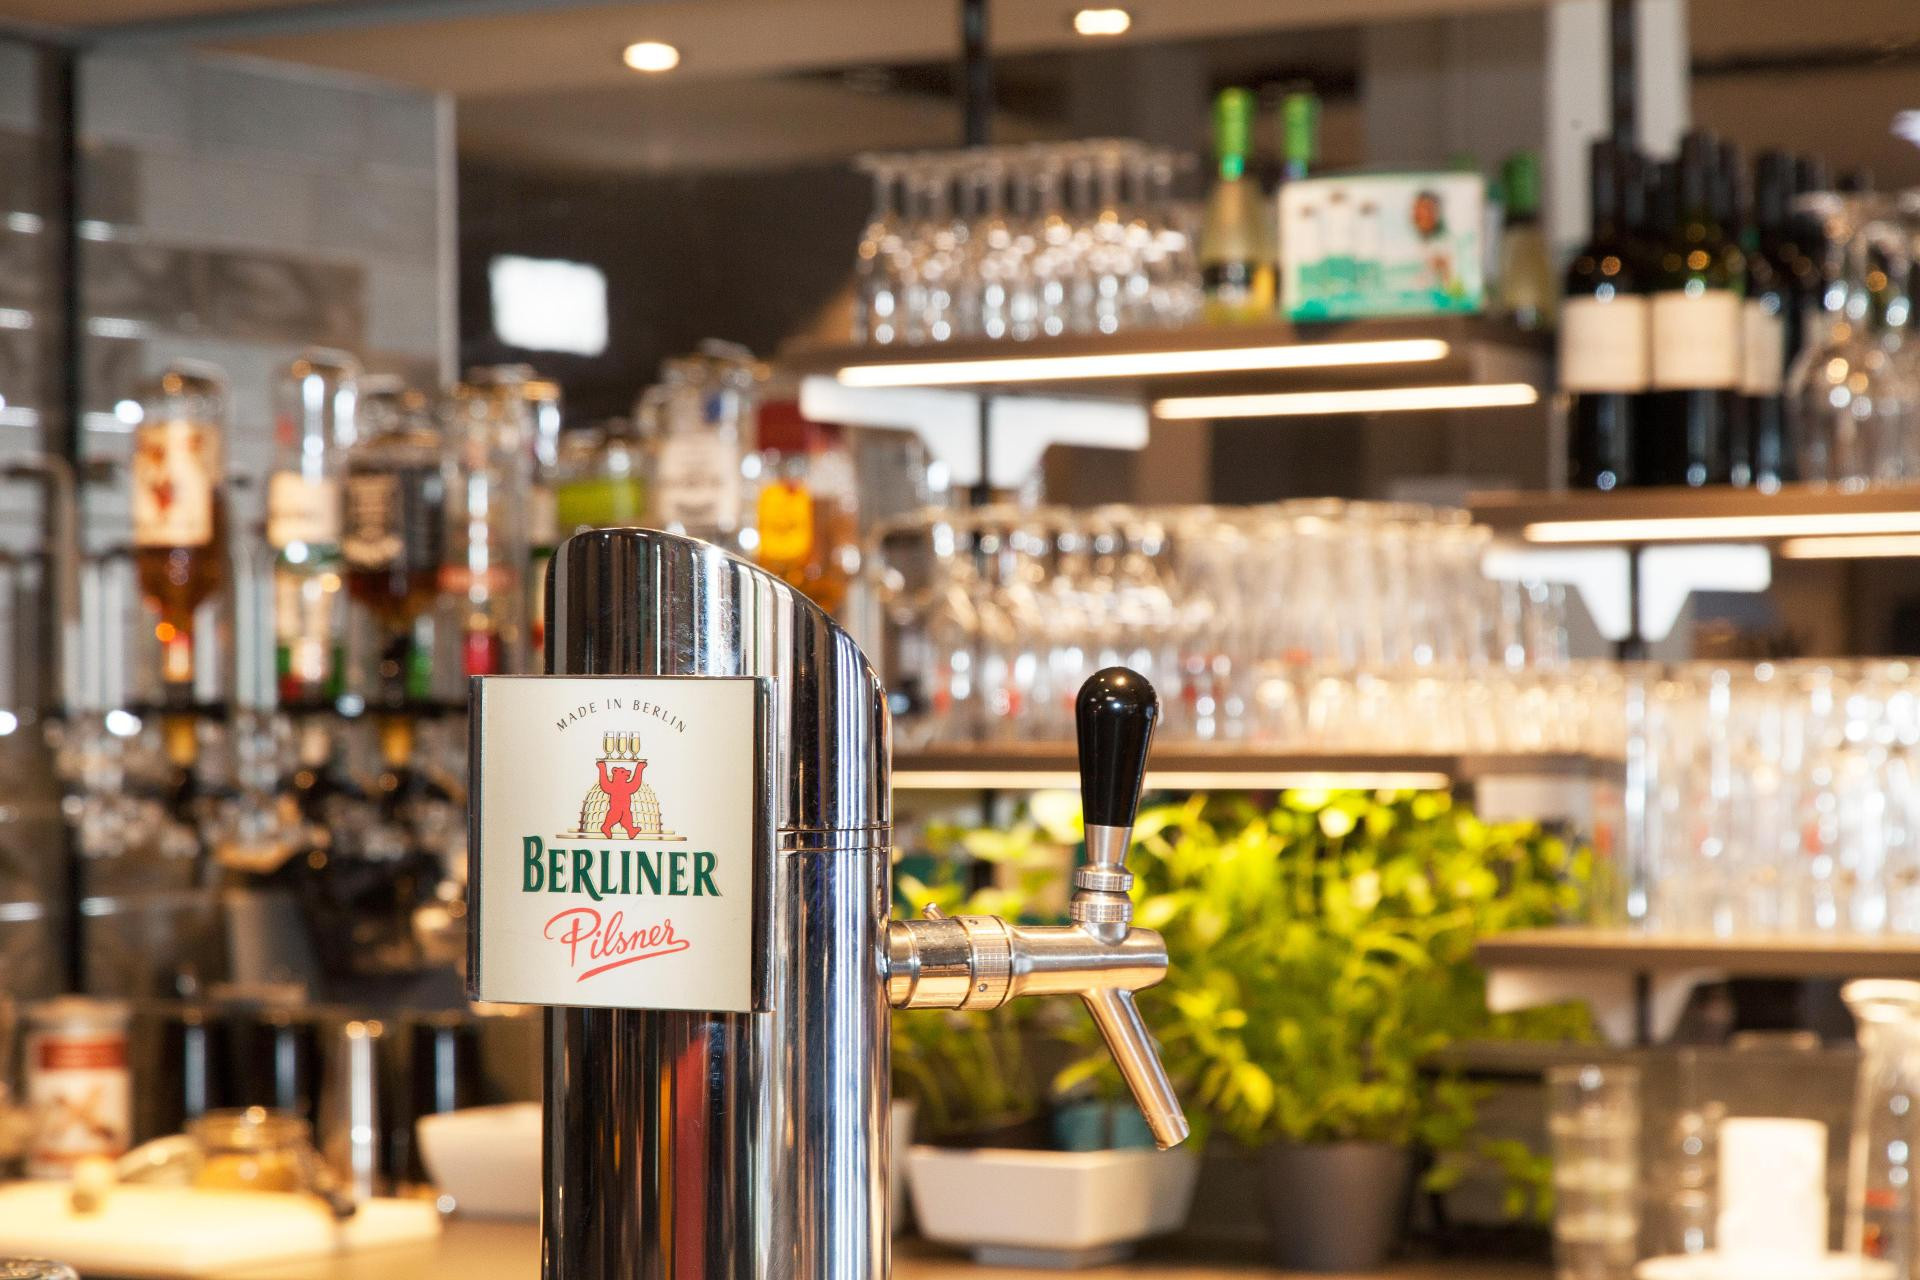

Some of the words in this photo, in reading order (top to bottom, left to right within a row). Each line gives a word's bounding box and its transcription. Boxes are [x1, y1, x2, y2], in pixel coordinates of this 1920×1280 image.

[556, 702, 598, 731] MADE
[606, 698, 623, 710] IN
[632, 699, 688, 733] BERLIN
[522, 835, 723, 902] BERLINER
[544, 907, 690, 982] Pilsner
